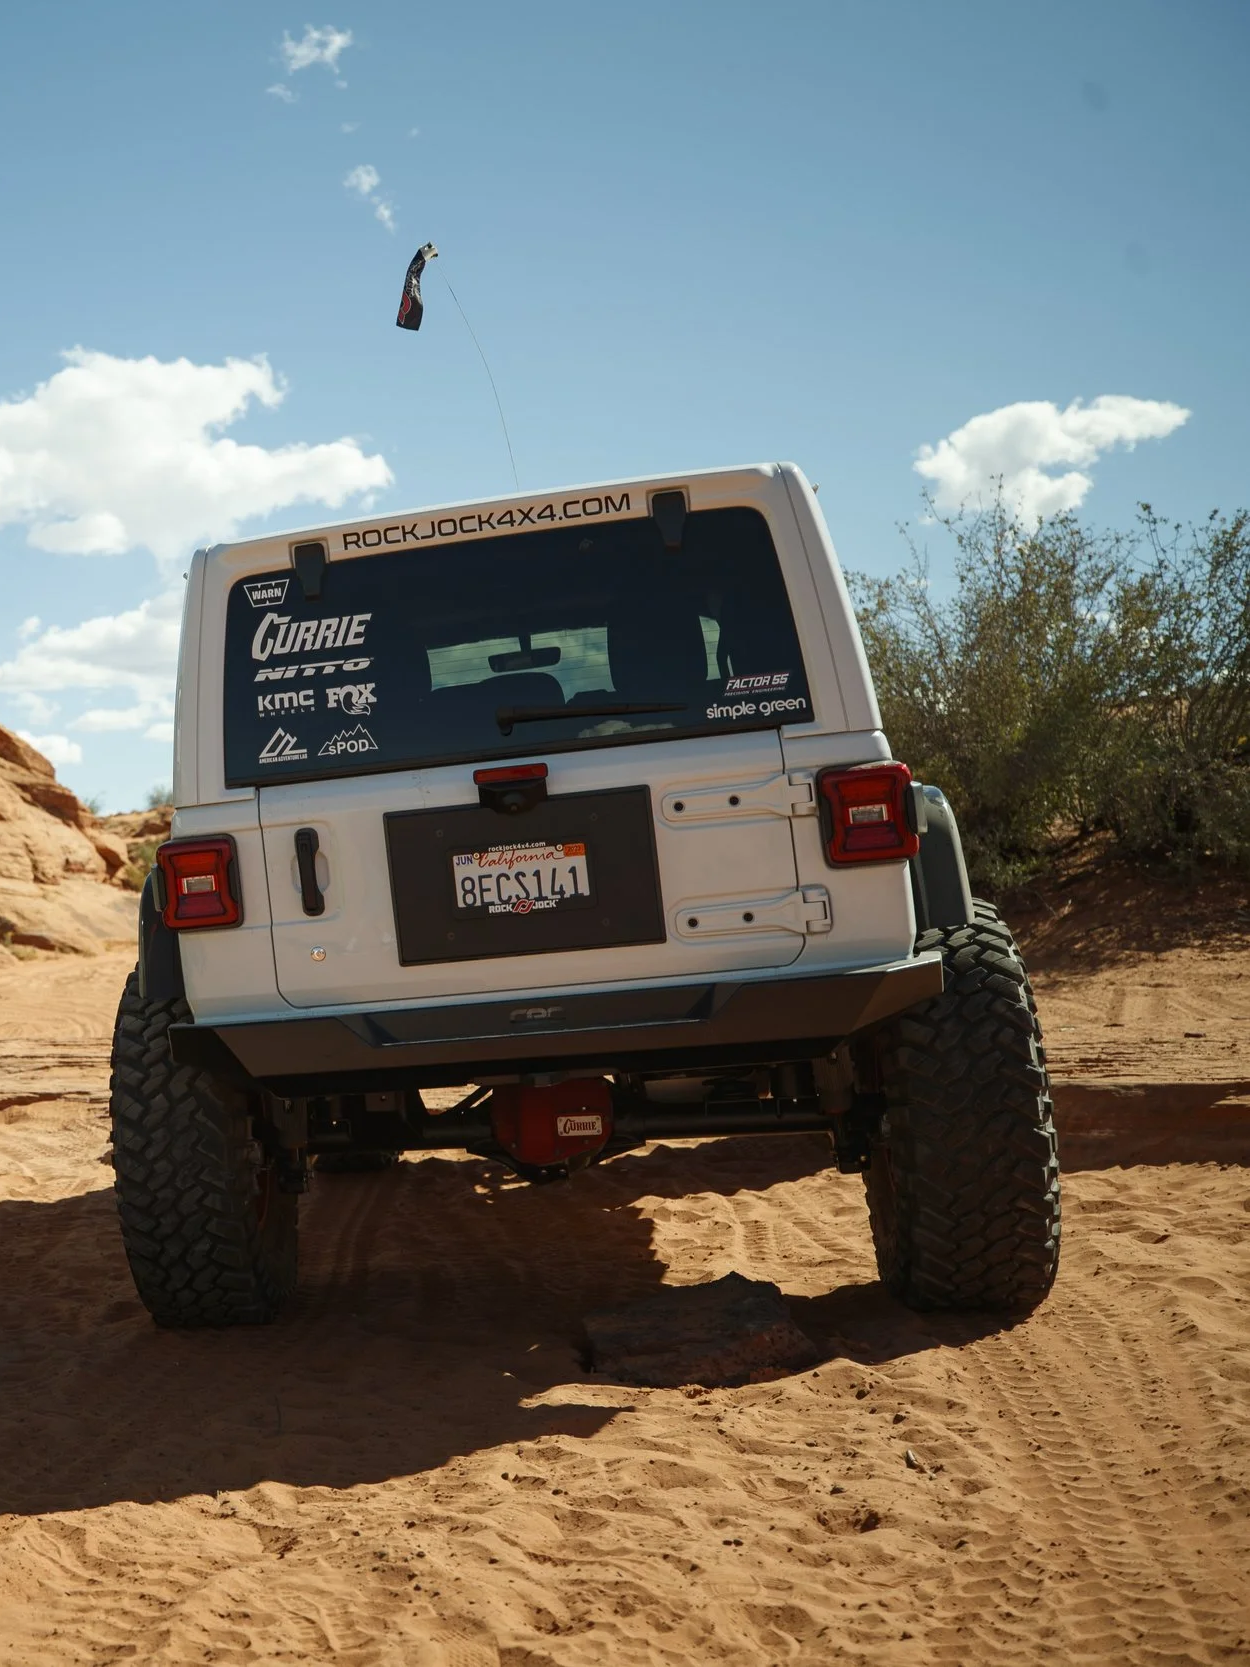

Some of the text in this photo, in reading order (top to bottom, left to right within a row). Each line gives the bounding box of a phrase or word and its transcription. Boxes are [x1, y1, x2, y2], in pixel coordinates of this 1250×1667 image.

[342, 493, 631, 550] ROCKJOCK4X4.COM
[252, 587, 282, 600] WARN
[251, 612, 372, 662] CURRIE
[726, 673, 789, 690] FACTOR 55
[326, 683, 377, 714] FOX
[259, 706, 315, 718] WHEELS
[706, 698, 806, 719] simple green
[328, 739, 369, 755] sPOD
[488, 841, 546, 852] rockjock4x4.com
[455, 855, 473, 866] JUN
[478, 851, 564, 870] California
[461, 866, 585, 907] 8ECS141
[489, 900, 557, 914] ROCK JOCK
[563, 1118, 597, 1134] CURRIE
